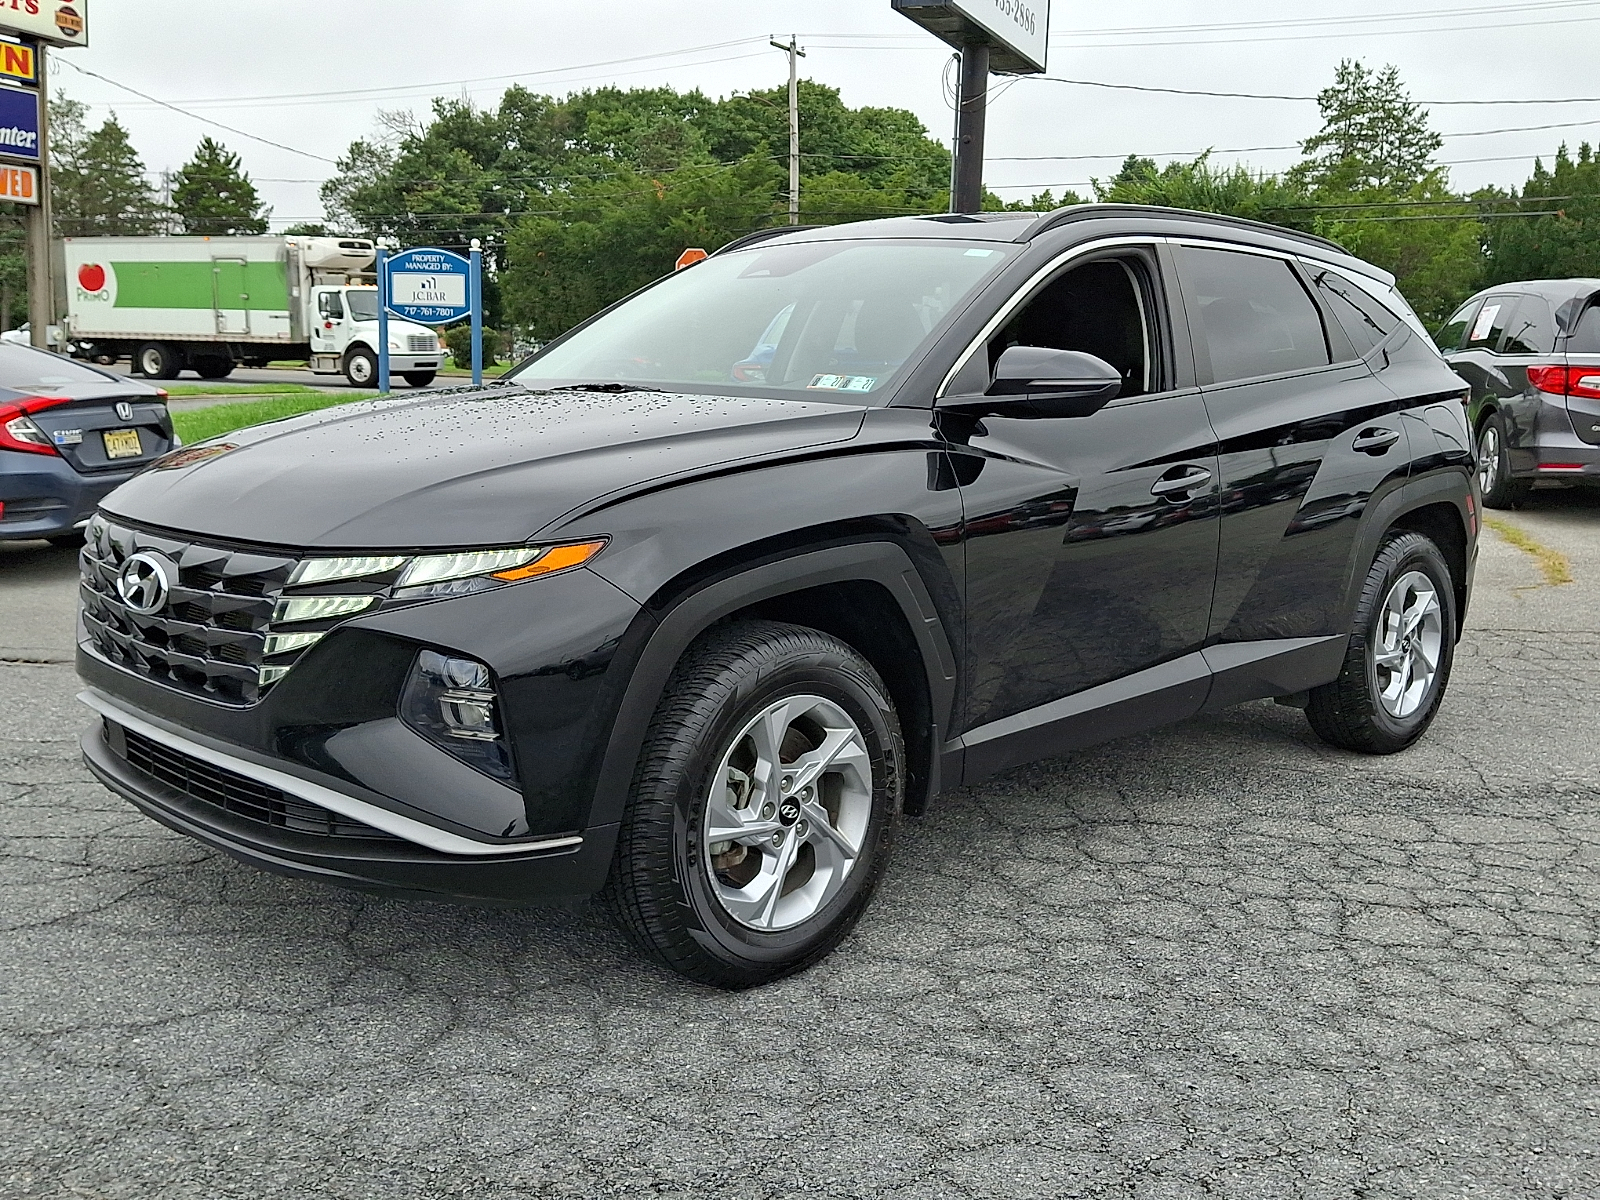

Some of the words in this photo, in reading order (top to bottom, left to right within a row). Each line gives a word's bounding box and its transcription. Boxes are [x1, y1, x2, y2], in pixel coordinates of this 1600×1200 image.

[0, 44, 29, 75] N
[412, 254, 445, 262] PROPERTY
[405, 262, 440, 270] MANAGED
[404, 306, 454, 316] 717-761-7801
